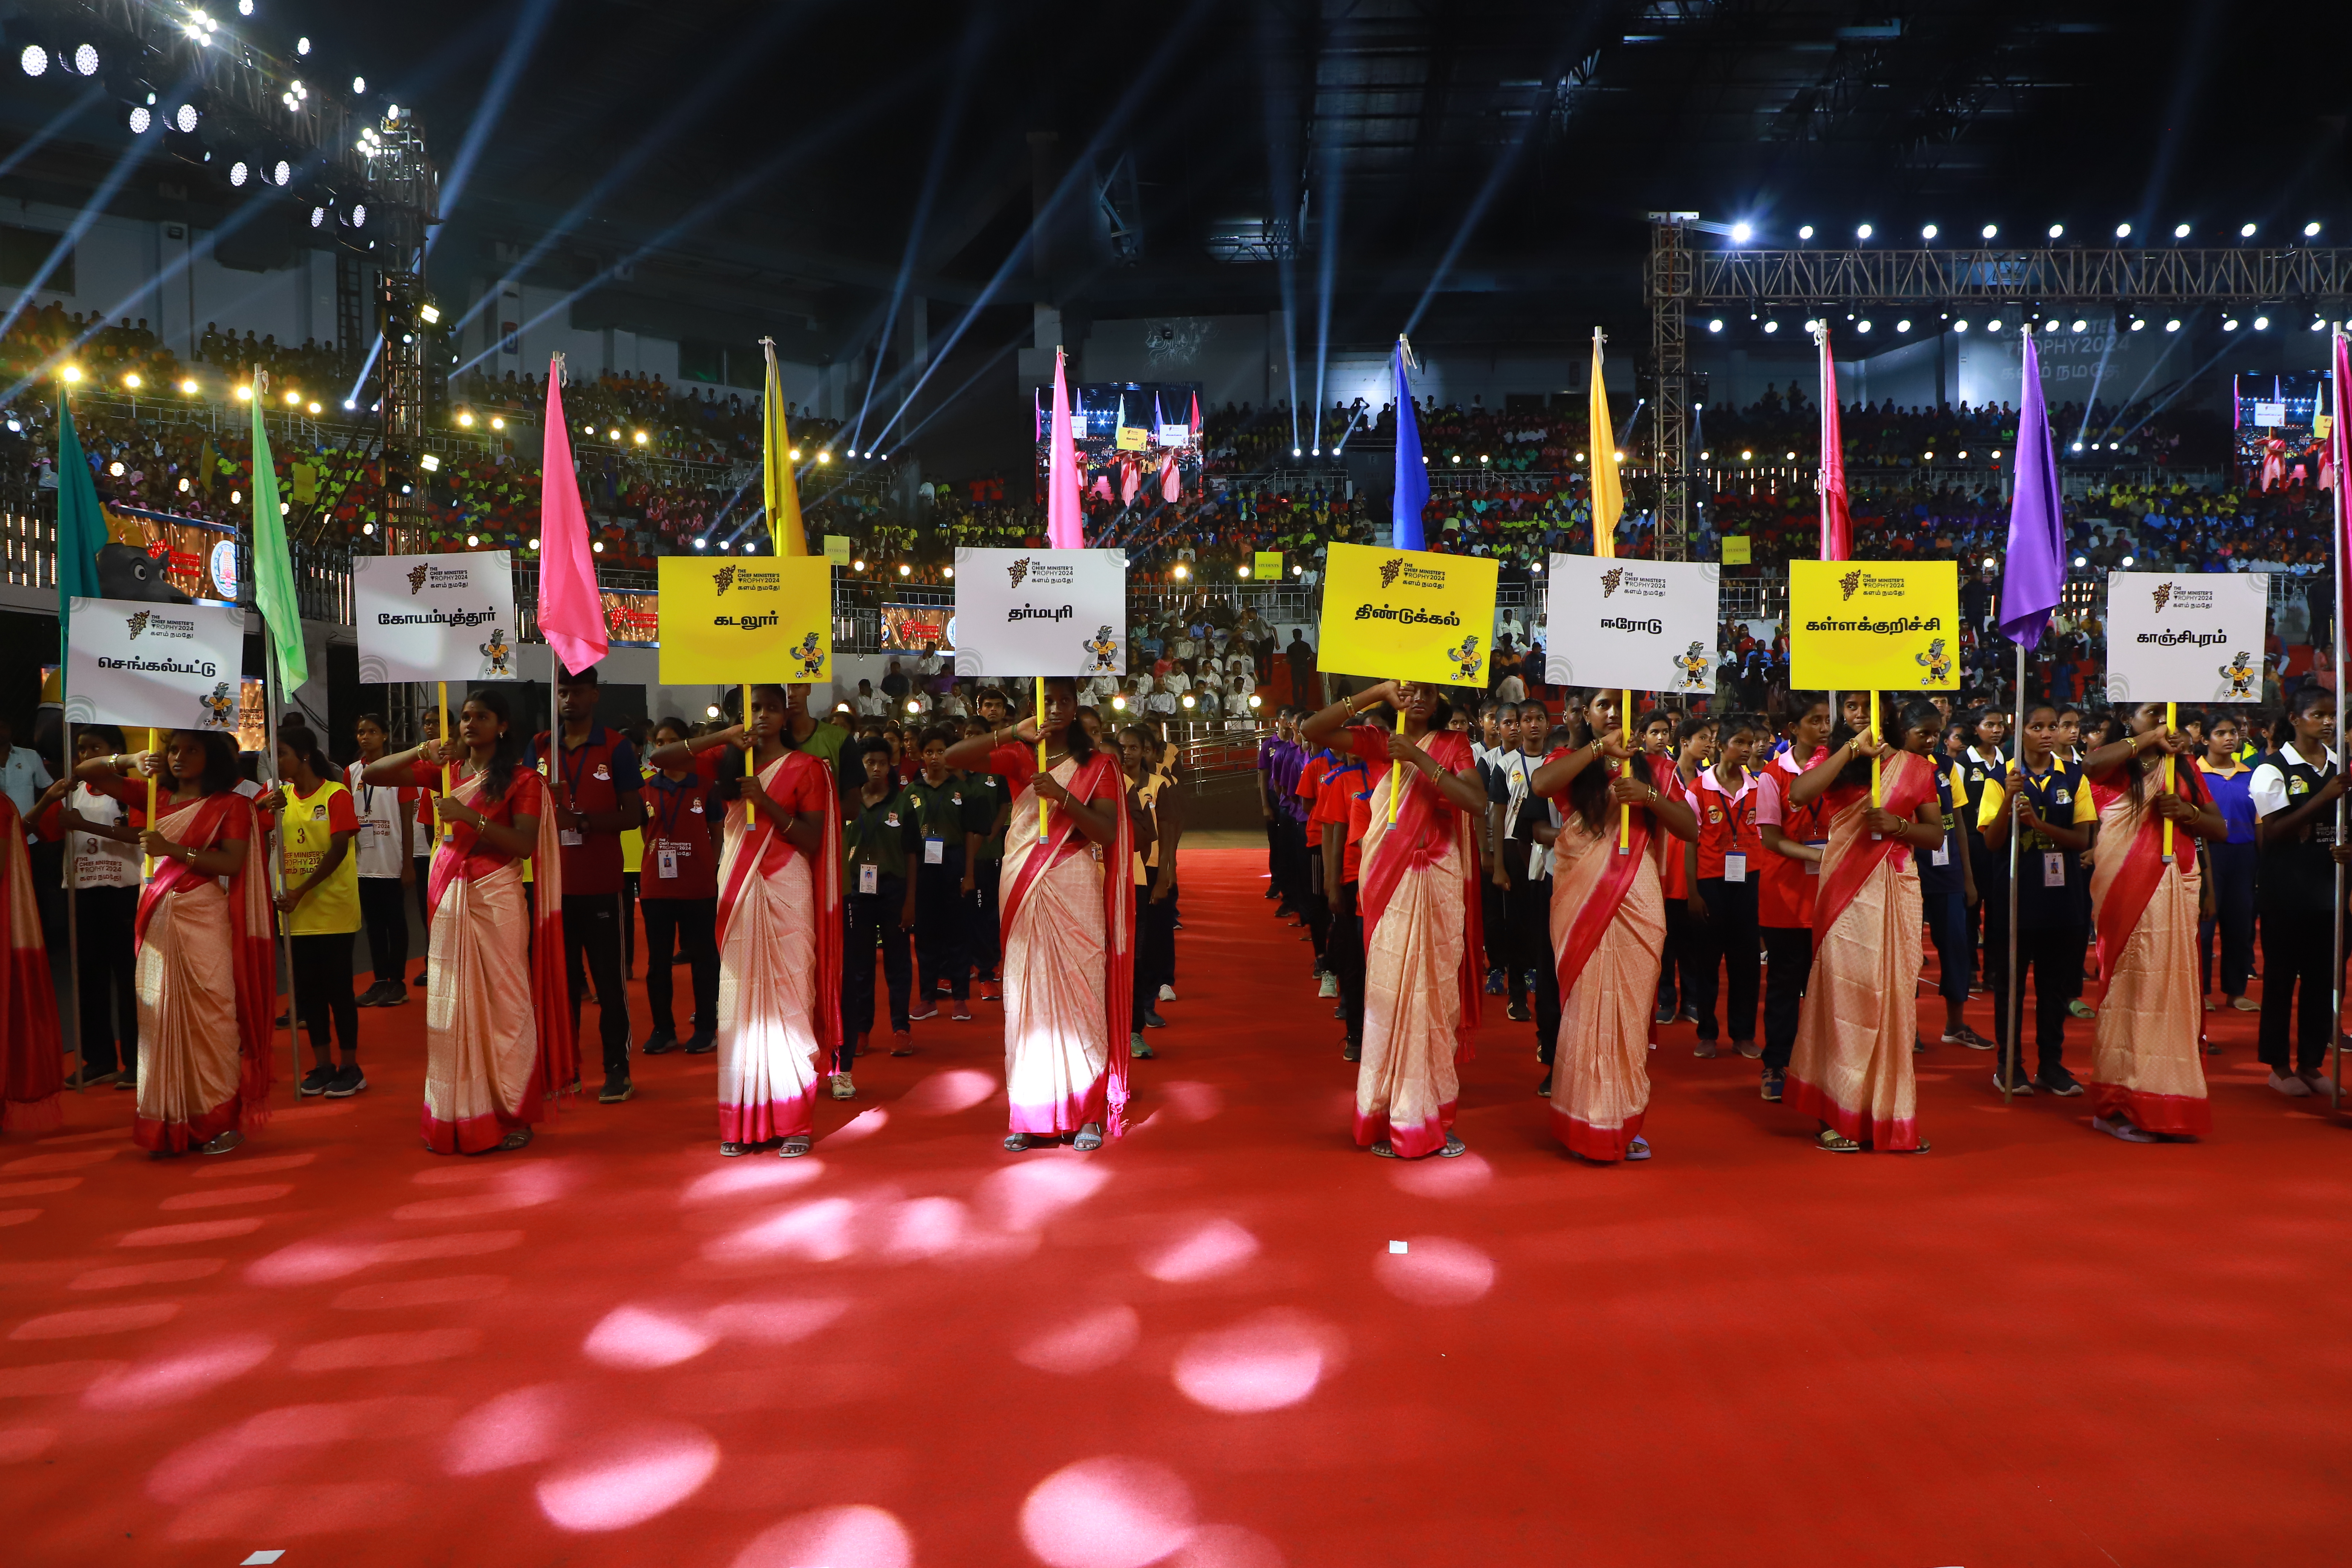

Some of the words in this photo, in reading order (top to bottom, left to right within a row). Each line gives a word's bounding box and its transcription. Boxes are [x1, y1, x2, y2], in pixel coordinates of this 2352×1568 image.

[378, 606, 496, 627] கோயம்புத்தூர்
[714, 610, 779, 630] கடலூர்
[1008, 603, 1073, 623] தர்மபுரி
[1354, 603, 1460, 626] திண்டுக்கல்
[1601, 617, 1662, 634] ஈரோடு
[1806, 616, 1940, 635] கள்ளக்குறிச்சி
[2137, 628, 2227, 648] காஞ்சிபுரம்
[98, 655, 216, 677] செங்கல்பட்டு
[297, 828, 305, 844] 3
[86, 838, 99, 855] 3
